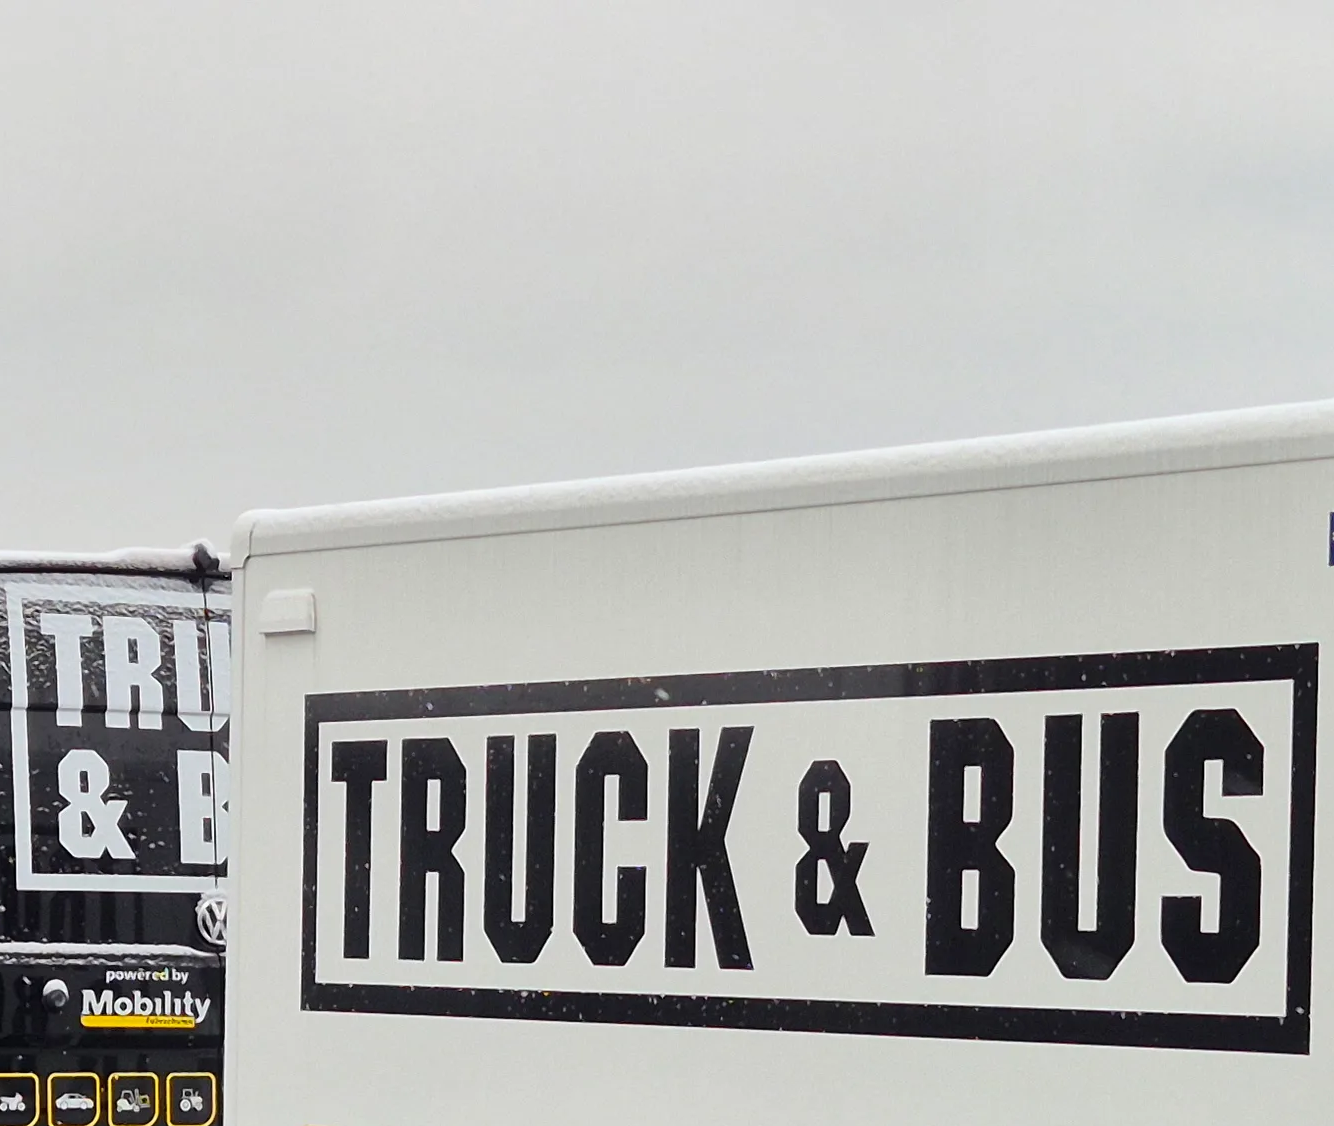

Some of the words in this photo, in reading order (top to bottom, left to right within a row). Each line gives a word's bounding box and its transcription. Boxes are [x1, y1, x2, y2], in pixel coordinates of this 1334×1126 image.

[40, 613, 231, 732] TRU
[58, 749, 136, 859] &
[331, 726, 755, 970] TRUCK
[795, 760, 875, 937] &
[925, 708, 1264, 984] BUS
[81, 989, 211, 1024] Mobility
[106, 967, 169, 984] powered
[172, 968, 189, 985] by
